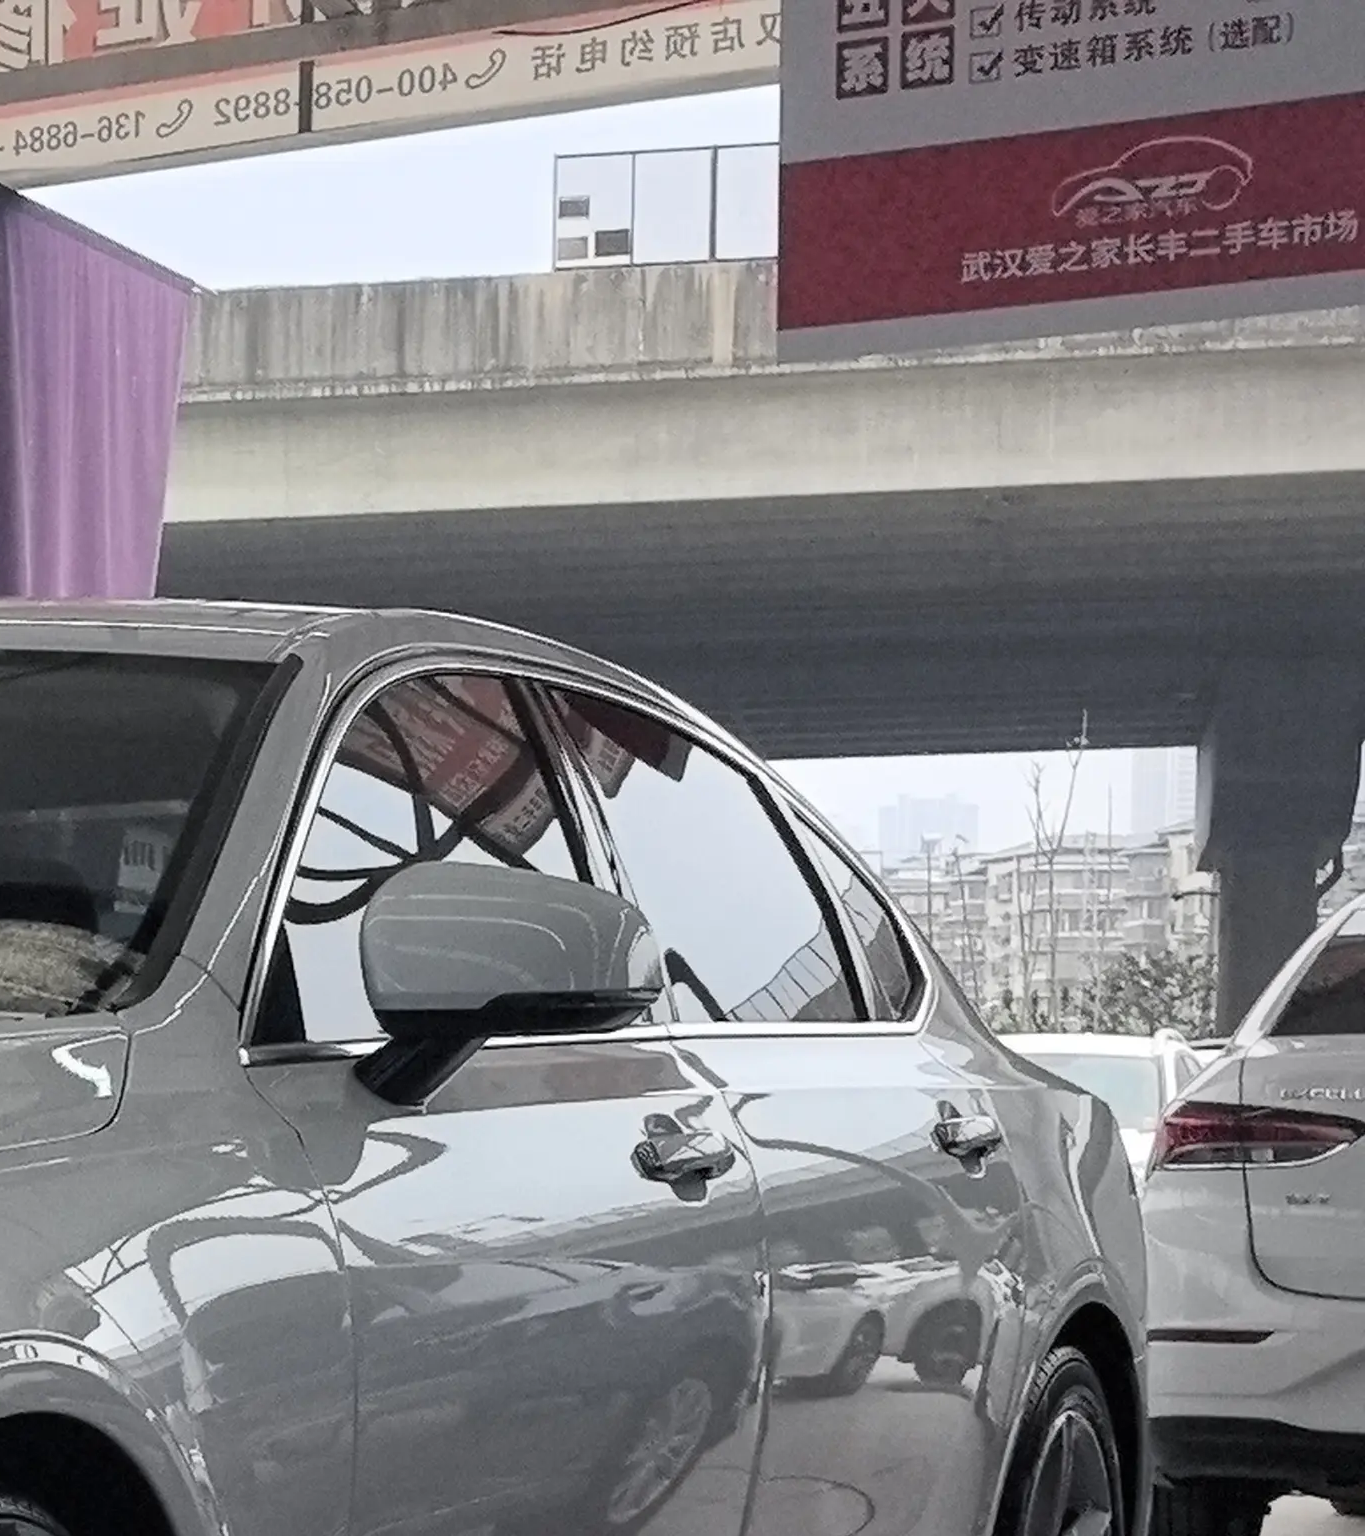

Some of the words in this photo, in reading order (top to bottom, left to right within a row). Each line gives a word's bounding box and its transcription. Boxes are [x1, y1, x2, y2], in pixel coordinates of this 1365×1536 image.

[839, 34, 951, 93] 系统
[960, 209, 1359, 284] 武汉爱之家长丰二手车市场
